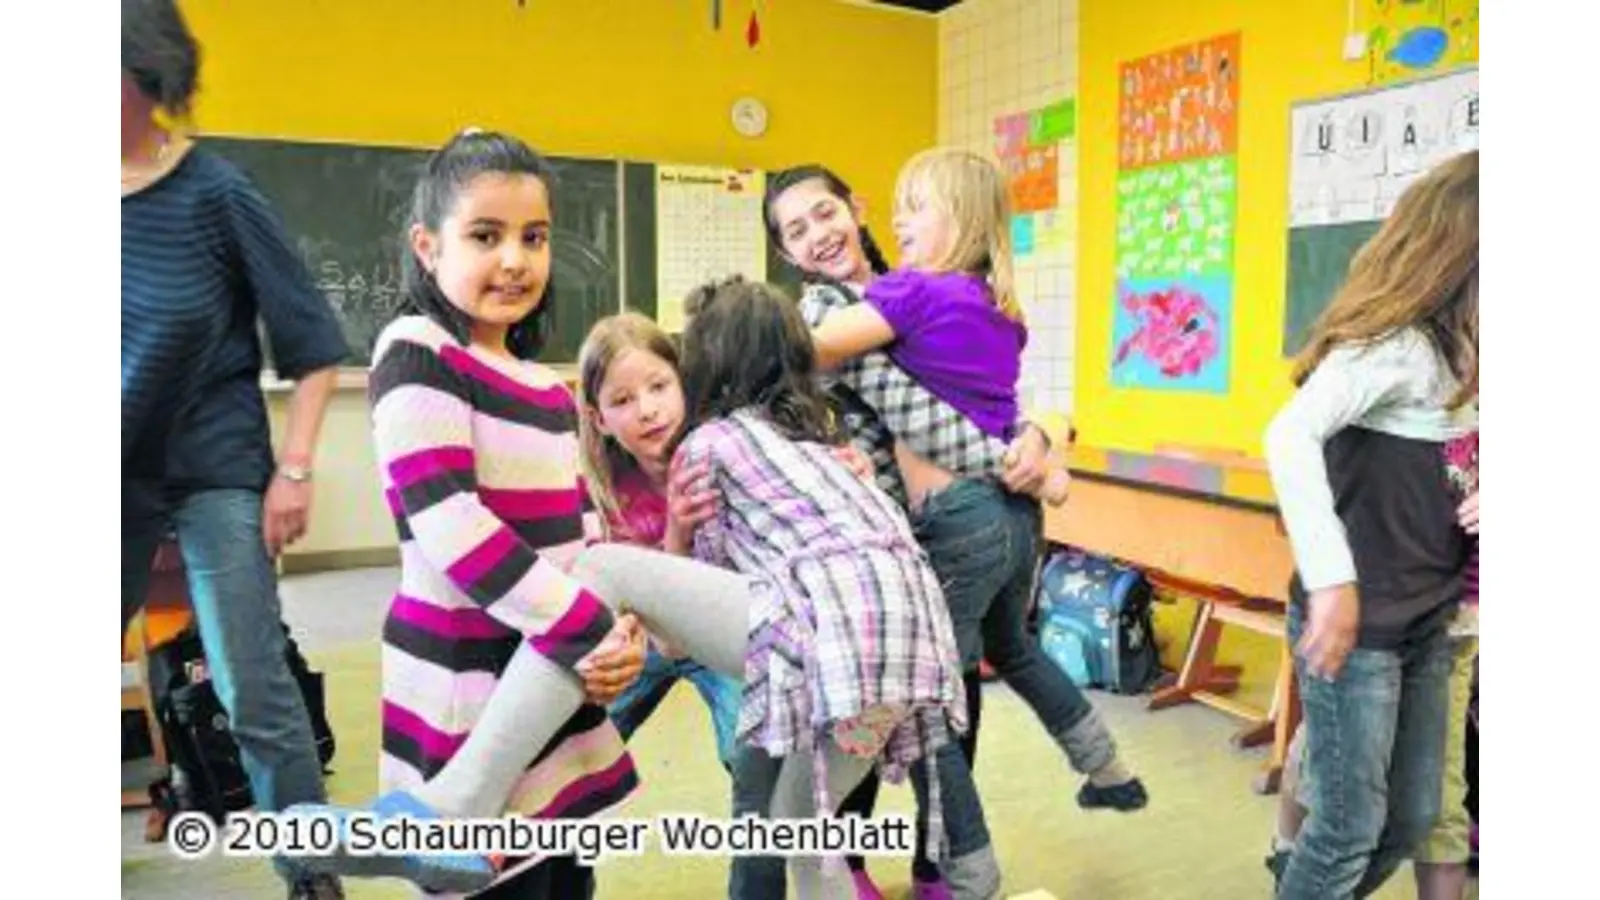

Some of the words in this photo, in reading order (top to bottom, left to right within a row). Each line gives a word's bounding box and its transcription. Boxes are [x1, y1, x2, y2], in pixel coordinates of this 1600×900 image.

[1317, 124, 1333, 150] U
[1360, 115, 1370, 144] I
[1403, 123, 1417, 145] A
